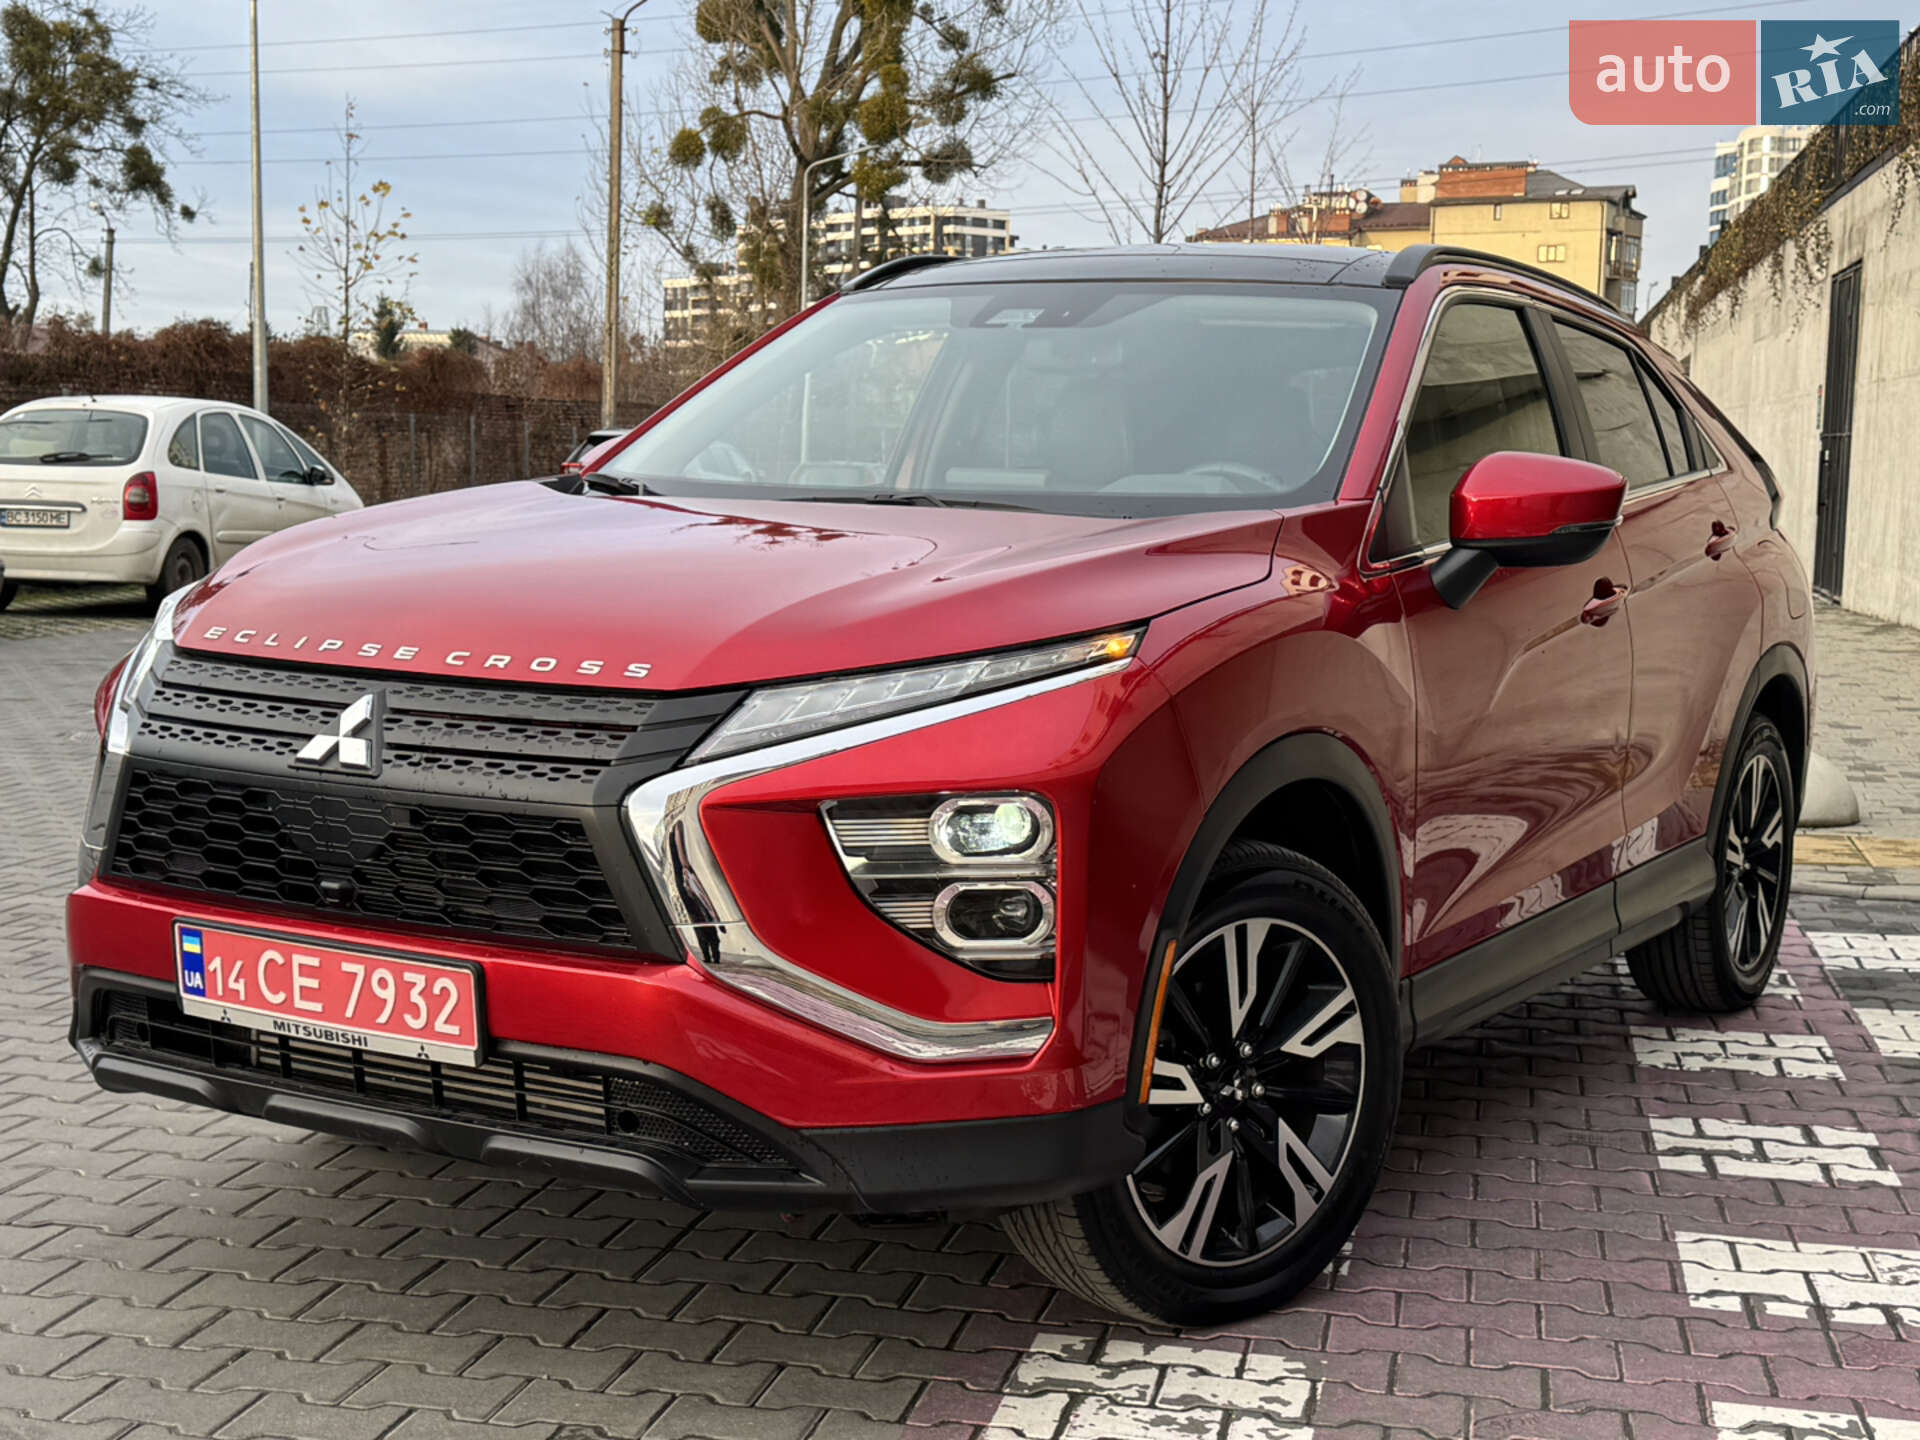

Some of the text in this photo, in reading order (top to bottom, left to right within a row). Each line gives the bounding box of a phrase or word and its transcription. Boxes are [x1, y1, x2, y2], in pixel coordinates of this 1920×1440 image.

[7, 511, 22, 522] BC
[203, 626, 652, 679] ECLIPSE CROSS
[185, 969, 204, 990] UA
[207, 949, 462, 1036] 14 CE 7932
[273, 1019, 369, 1048] MITSUBISHI
